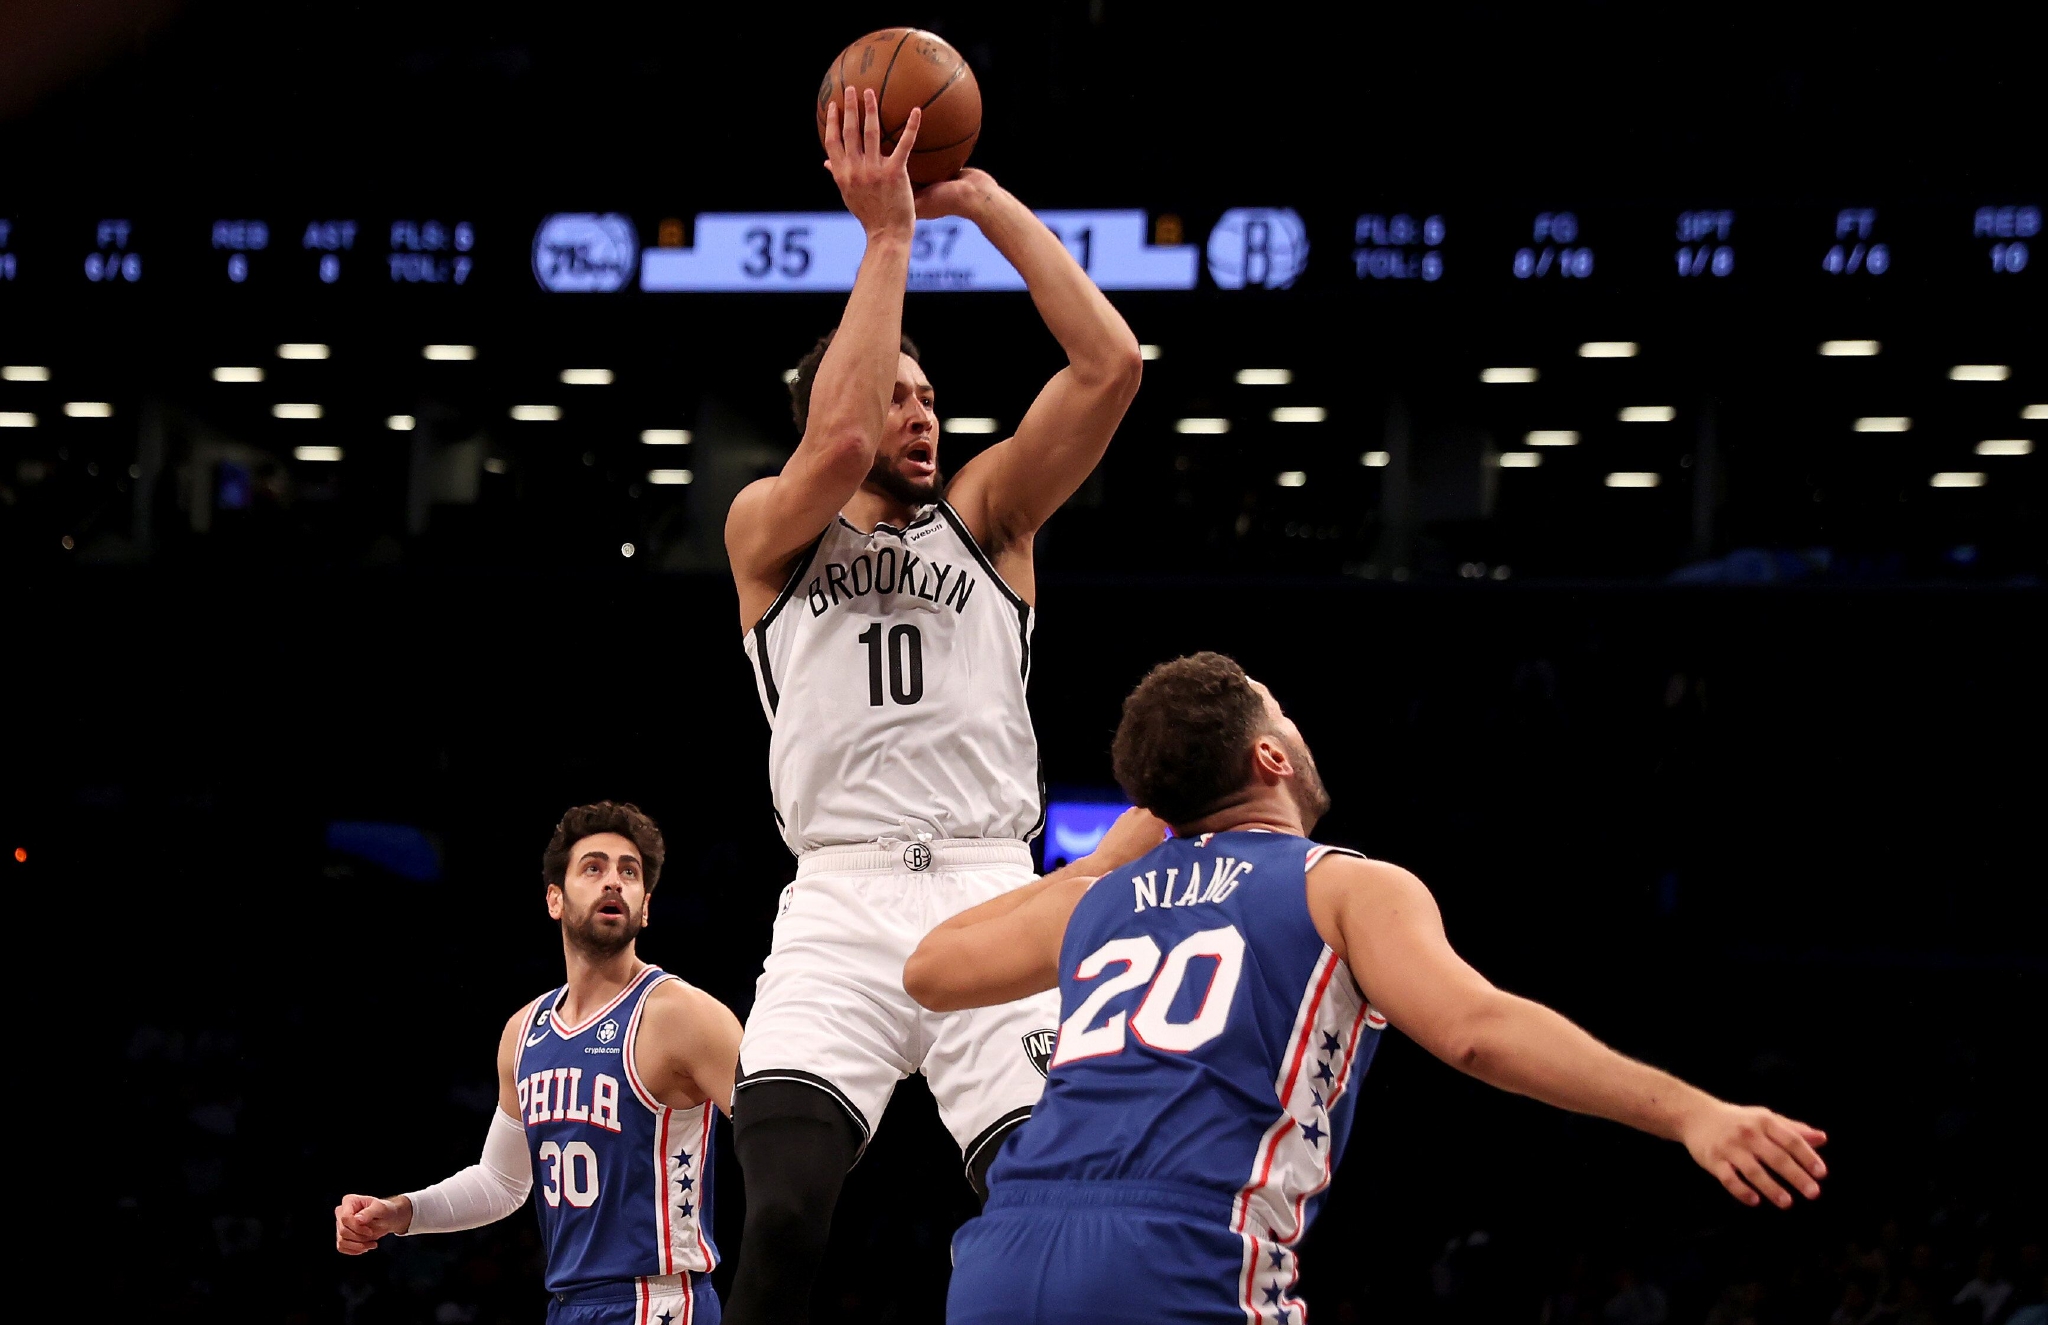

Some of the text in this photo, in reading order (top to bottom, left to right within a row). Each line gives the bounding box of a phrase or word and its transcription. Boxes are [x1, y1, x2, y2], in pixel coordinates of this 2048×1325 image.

[97, 220, 131, 250] FT
[1836, 208, 1875, 240] FT
[1974, 206, 2042, 238] REB
[743, 226, 815, 280] 35
[910, 523, 943, 542] Webull
[807, 547, 976, 619] BROOKLYN
[858, 622, 924, 707] 10
[1132, 857, 1253, 914] NIANG
[536, 1009, 551, 1026] 6
[1051, 925, 1247, 1069] 20
[584, 1046, 621, 1055] crypto.com
[517, 1067, 622, 1133] PHILA
[539, 1141, 600, 1208] 30
